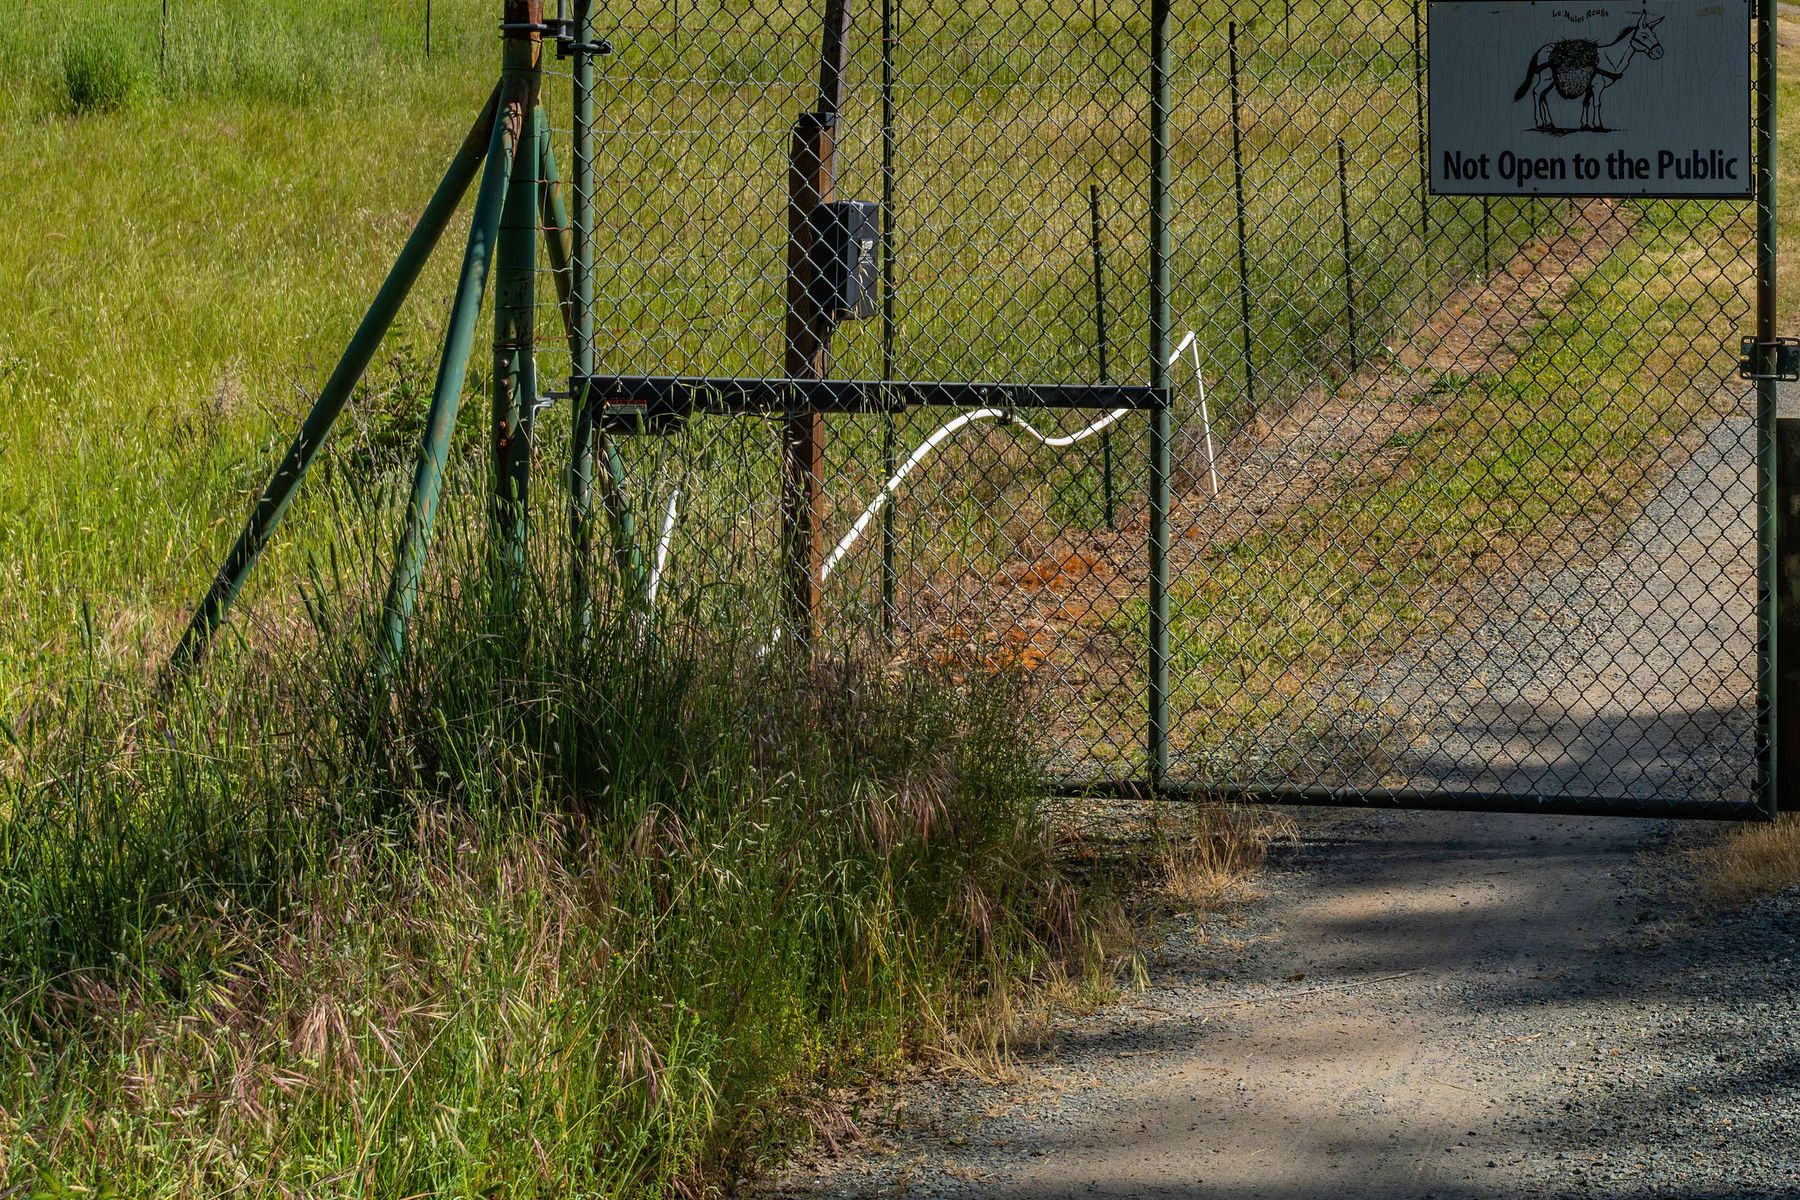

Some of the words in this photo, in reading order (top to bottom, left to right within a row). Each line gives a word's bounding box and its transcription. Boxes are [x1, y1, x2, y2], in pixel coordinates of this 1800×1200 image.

[1552, 9, 1561, 17] Le
[1563, 9, 1584, 23] Mulet
[1586, 8, 1609, 19] Rouge
[1444, 151, 1490, 180] Not
[1498, 150, 1566, 188] Open
[1572, 153, 1600, 180] to
[1605, 149, 1650, 180] the
[1658, 149, 1738, 180] Public
